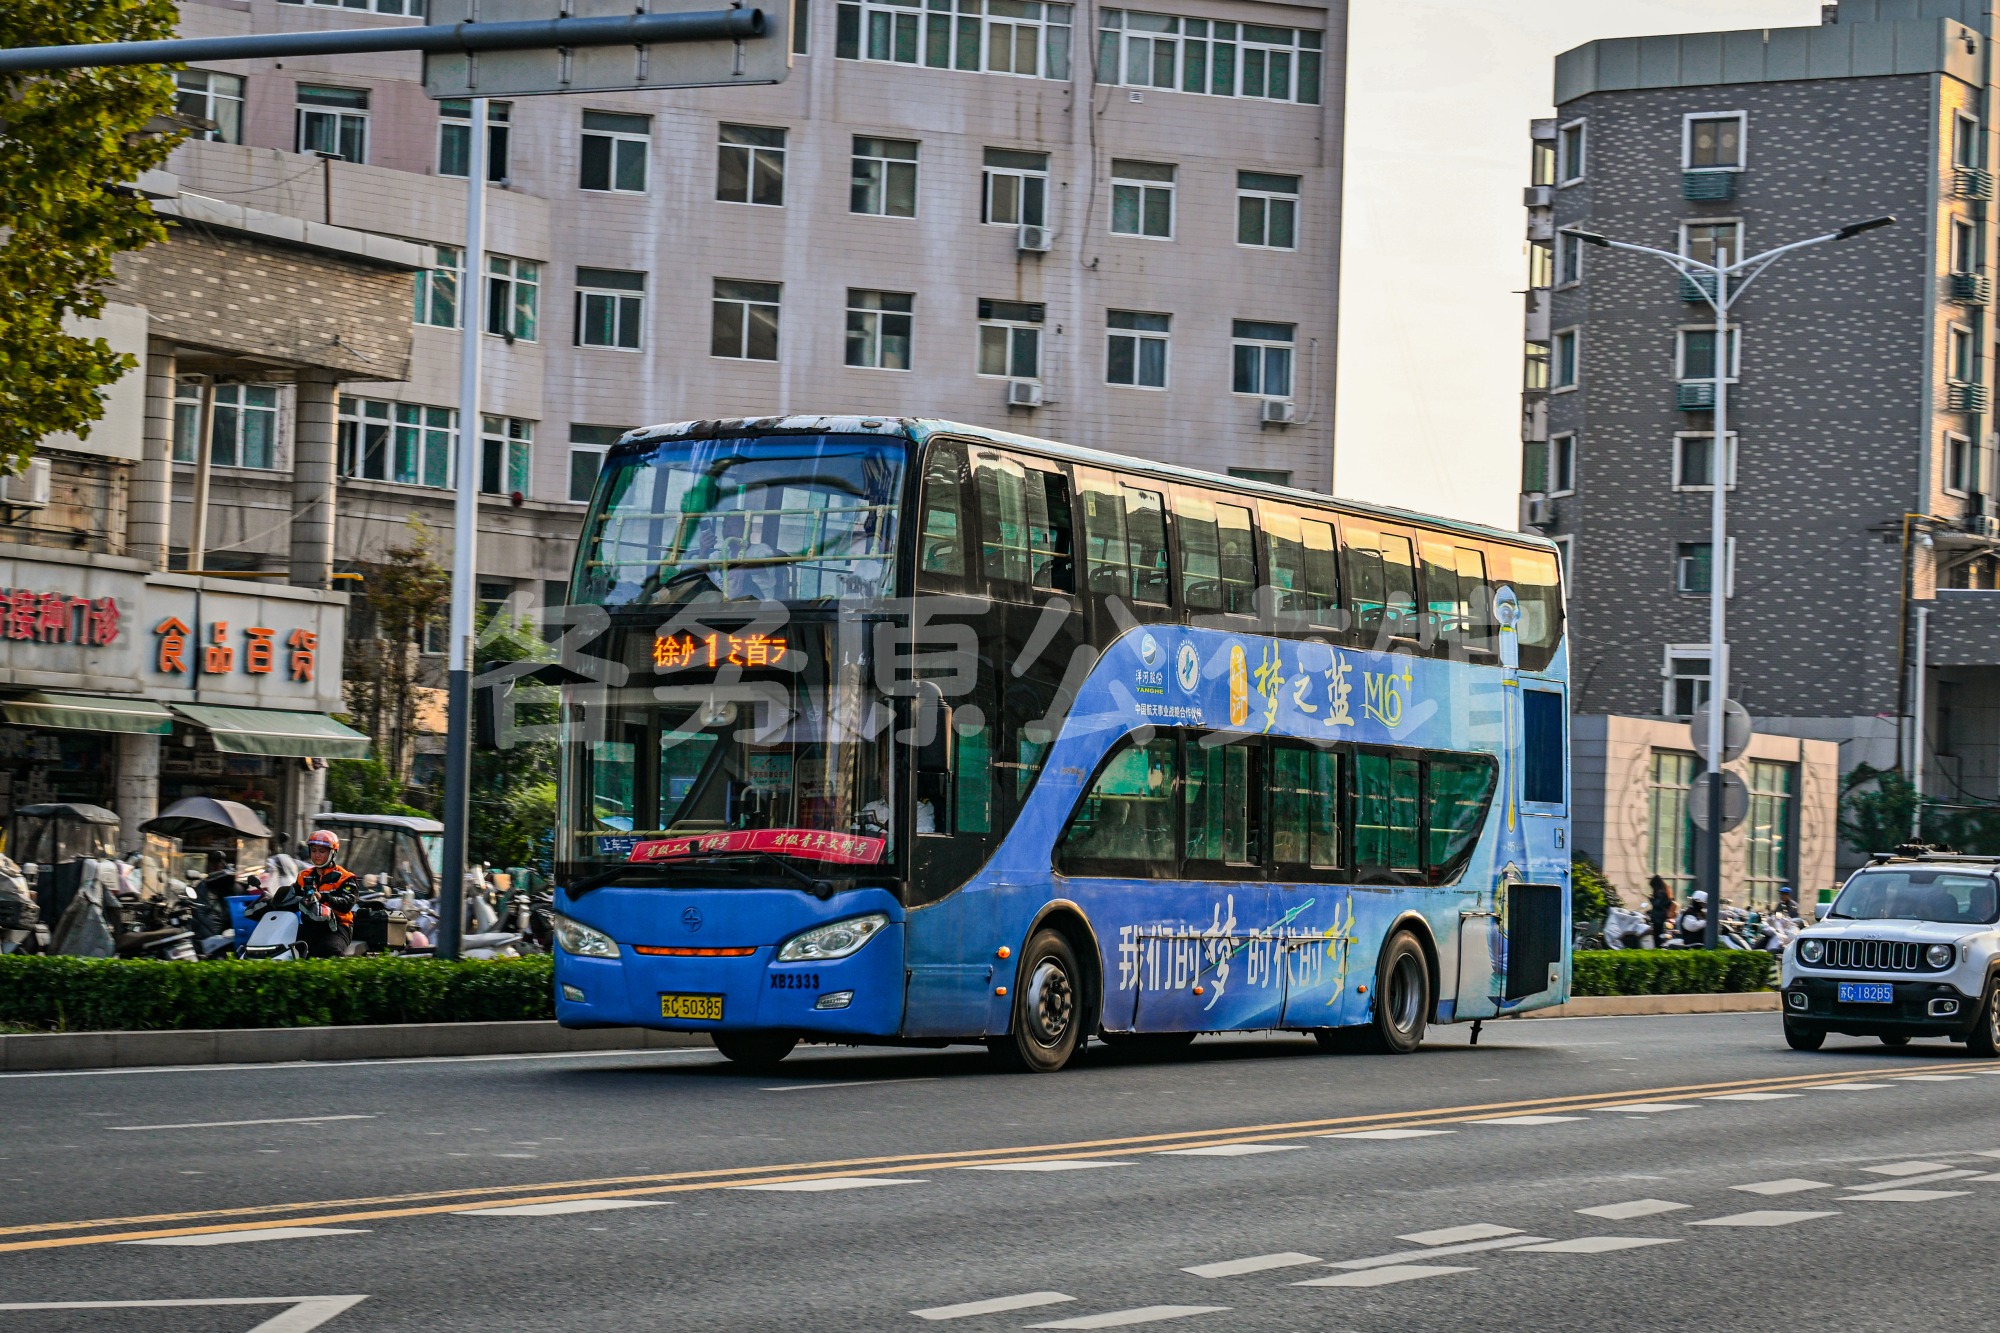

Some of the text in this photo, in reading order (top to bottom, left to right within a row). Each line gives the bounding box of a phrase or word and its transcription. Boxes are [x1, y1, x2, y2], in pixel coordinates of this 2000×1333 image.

[0, 587, 120, 646] 接种门诊
[155, 616, 318, 682] 食品百货
[1136, 686, 1164, 695] YANGHE
[1254, 640, 1354, 734] 梦之蓝
[772, 833, 868, 857] 省级青年文明号
[770, 973, 820, 989] XB2333
[1119, 893, 1358, 1011] 我们的梦 时代的梦
